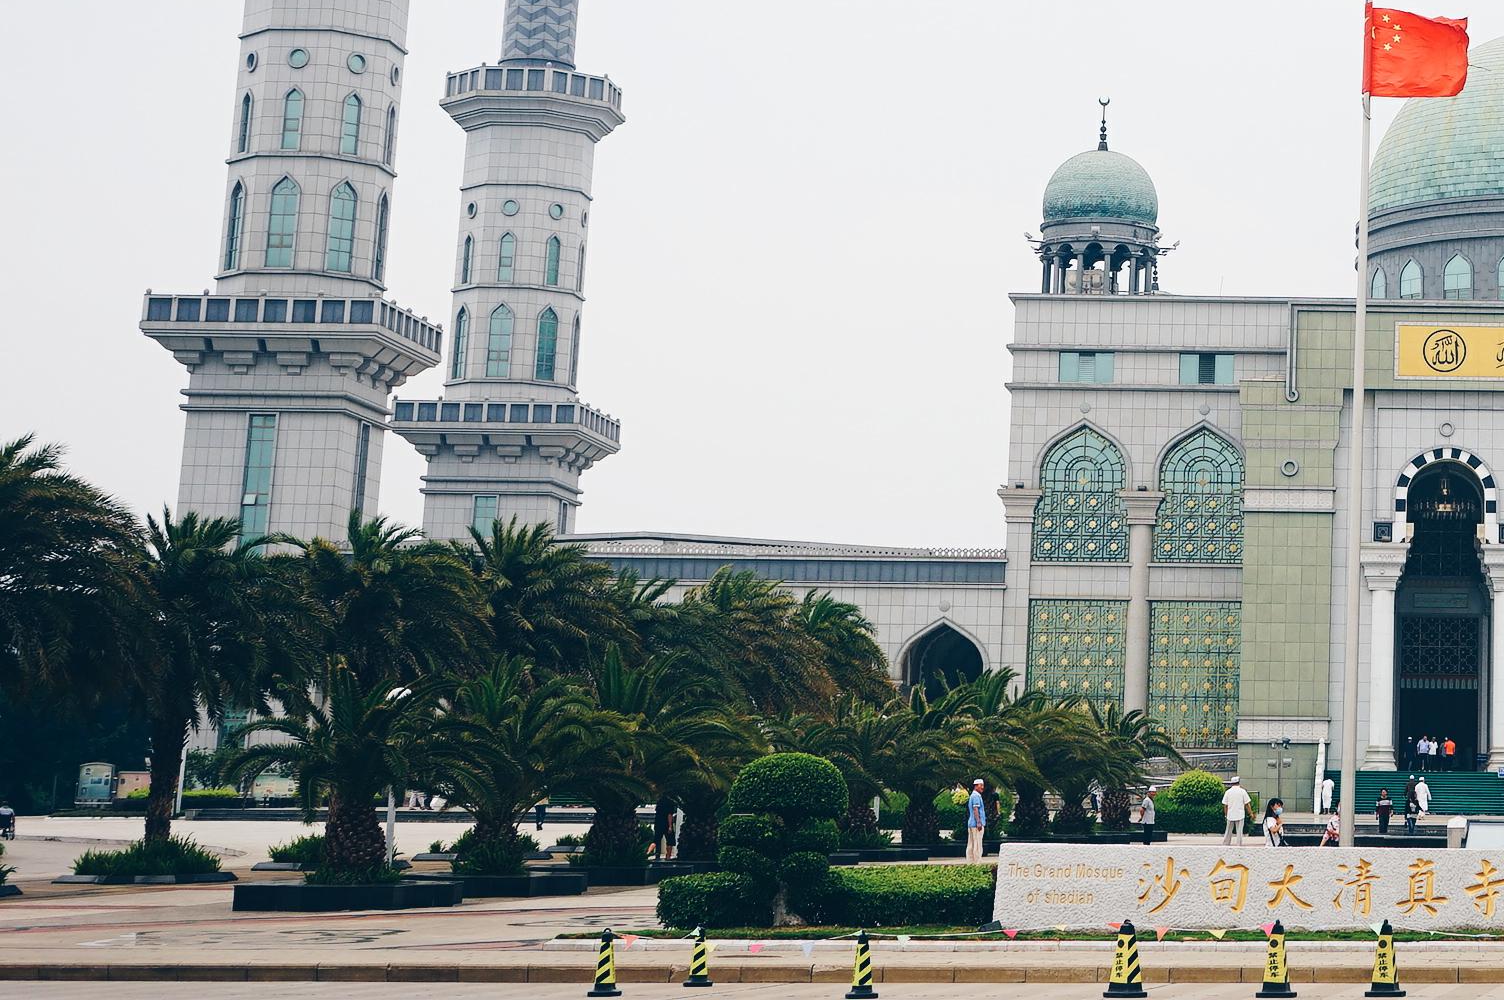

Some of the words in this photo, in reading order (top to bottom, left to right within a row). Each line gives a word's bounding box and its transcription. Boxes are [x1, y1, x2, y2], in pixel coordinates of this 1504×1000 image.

[1008, 862, 1030, 878] The
[1033, 863, 1073, 879] Grand
[1075, 862, 1124, 882] Mosque
[1026, 888, 1041, 904] of
[1044, 889, 1094, 905] shadian
